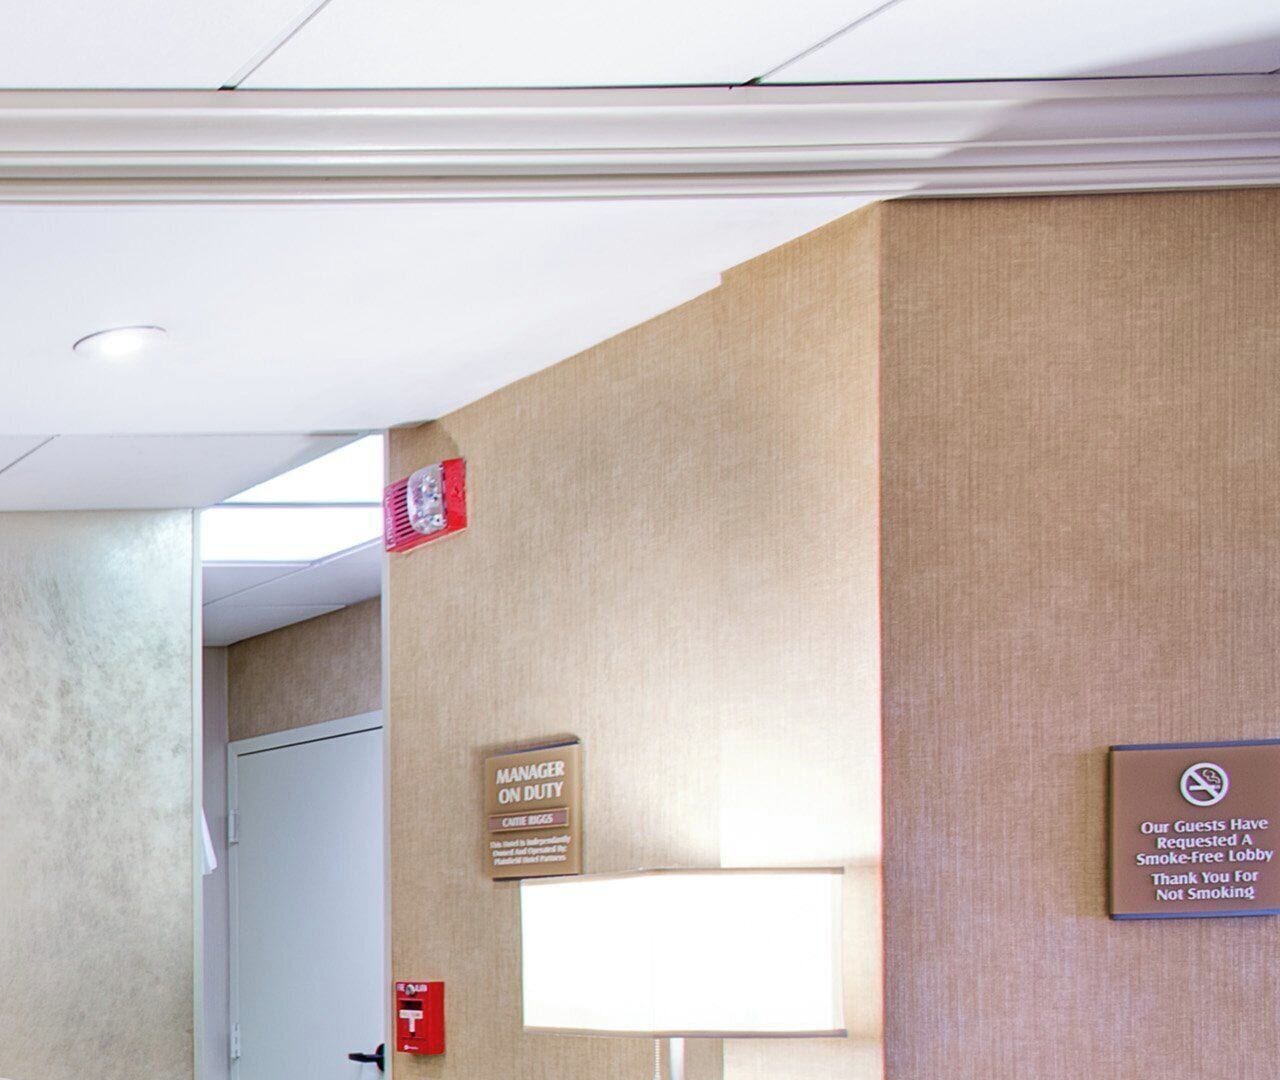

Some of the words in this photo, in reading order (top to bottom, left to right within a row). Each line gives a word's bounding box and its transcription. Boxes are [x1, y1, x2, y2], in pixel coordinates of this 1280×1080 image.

[496, 760, 565, 785] MANAGER
[498, 787, 521, 804] ON
[524, 781, 564, 801] DUTY
[1141, 820, 1169, 834] Our
[1174, 819, 1226, 832] Guests
[1230, 818, 1269, 831] Have
[1157, 834, 1237, 850] Requested
[1241, 834, 1253, 846] A
[1136, 851, 1224, 866] Smoke-Free
[1228, 848, 1273, 863] Lobby
[1151, 872, 1198, 885] Thank
[1201, 871, 1229, 884] You
[1234, 870, 1259, 882] For
[1156, 888, 1183, 901] Not
[1187, 886, 1256, 900] Smoking
